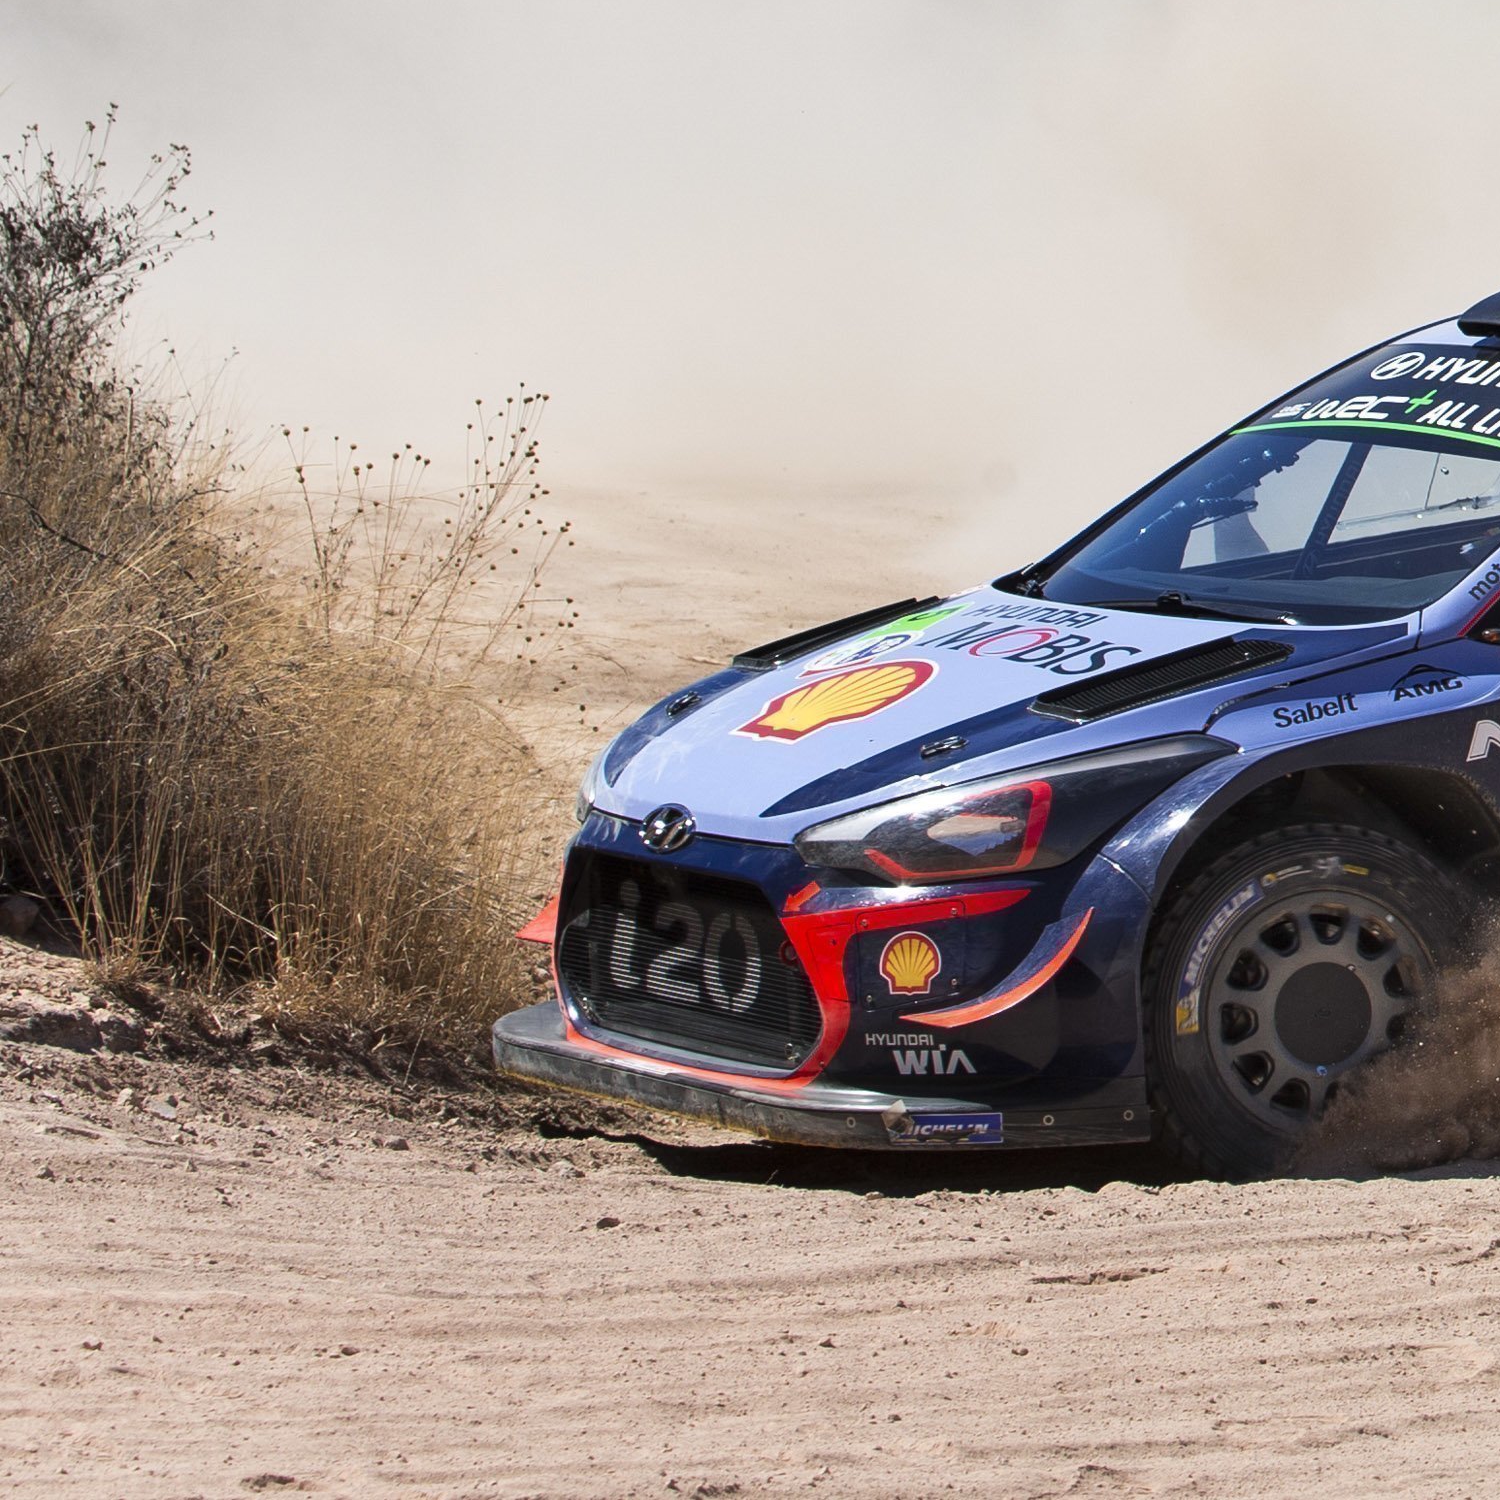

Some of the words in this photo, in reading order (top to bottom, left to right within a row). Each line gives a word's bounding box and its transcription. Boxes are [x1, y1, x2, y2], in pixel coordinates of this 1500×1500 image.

[1416, 400, 1479, 429] ALL
[960, 603, 1109, 629] HYUNDAI
[917, 621, 1143, 676] MOBIS
[1393, 677, 1463, 702] AMG
[1273, 692, 1358, 728] Sabelt
[865, 1033, 934, 1046] HYUNDAI
[892, 1044, 977, 1075] WIA
